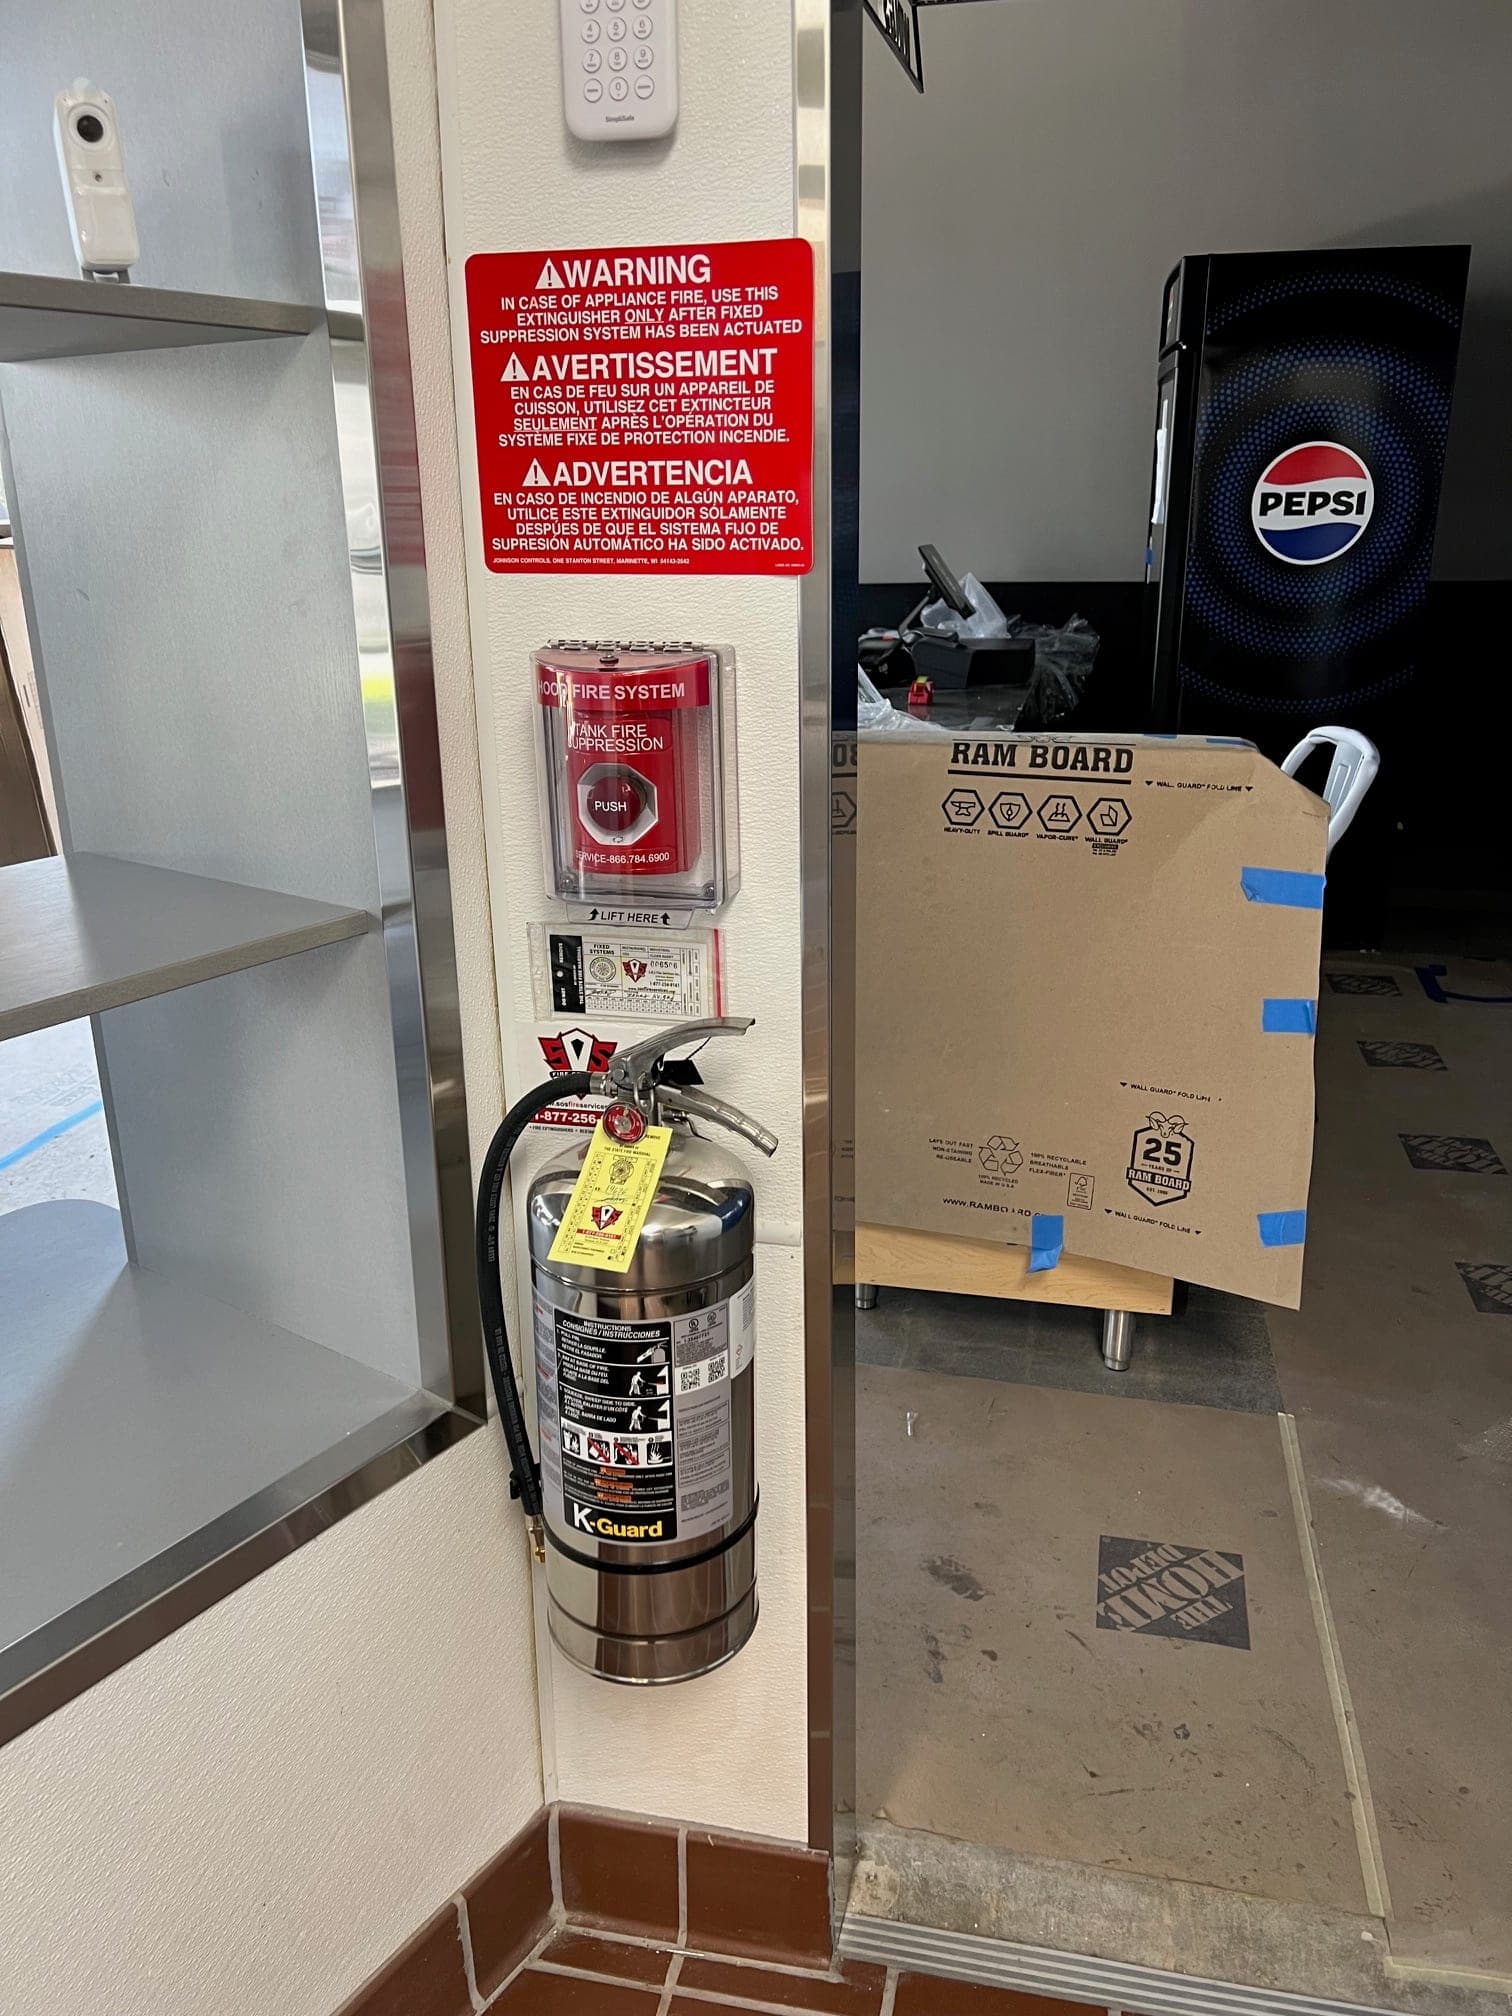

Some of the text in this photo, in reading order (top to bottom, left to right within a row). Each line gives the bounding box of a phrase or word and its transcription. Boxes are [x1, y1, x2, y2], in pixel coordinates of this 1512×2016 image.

[563, 254, 710, 288] WARNING
[501, 286, 778, 310] IN CASE OF APPLIANCE FIRE, USE THIS
[517, 304, 763, 326] EXTINGUISHER ONLY AFTER FIXED
[480, 319, 802, 344] SUPPRESSION SYSTEM HAS BEEN ACTUATED
[532, 348, 778, 381] AVERTISSEMENT
[511, 380, 774, 399] EN CAS DE FEU SUR UN APPAREIL DE
[515, 397, 771, 416] CUISSON, UTILISEZ CET EXTINCTEUR
[514, 411, 773, 434] SEULEMENT APRÈS L'OPÉRATION DU
[499, 429, 789, 447] SYSTÈME FIXE DE PROTECTION INCENDIE.
[553, 459, 753, 486] ADVERTENCIA
[494, 488, 799, 505] EN CASO DE INCENDIO DE ALGÚN APARATO,
[1259, 490, 1367, 516] PEPSI
[508, 504, 786, 521] UTILICE ESTE EXTINGUIDOR SÓLAMENTE
[516, 520, 778, 535] DESPÚES DE QUE EL SISTEMA FIJO DE
[492, 535, 804, 550] SUPRESIÓN AUTOMÁTICO HA SIDO ACTIVADO.
[573, 684, 611, 699] FIRE
[614, 683, 685, 700] SYSTEM
[612, 724, 648, 738] FIRE
[951, 742, 1136, 774] RAM BOARD
[594, 800, 627, 812] PUSH
[600, 912, 658, 924] LIFT HERE
[1178, 1091, 1194, 1099] FOLD
[1143, 1138, 1182, 1166] 25
[1128, 1169, 1190, 1191] RAM BOARD
[1160, 1221, 1176, 1230] FOLD
[584, 1321, 631, 1332] INSTRUCTIONS
[602, 1330, 660, 1339] INSTRUCCIONES
[574, 1503, 663, 1538] K-Guard
[1097, 1550, 1244, 1632] HOME
